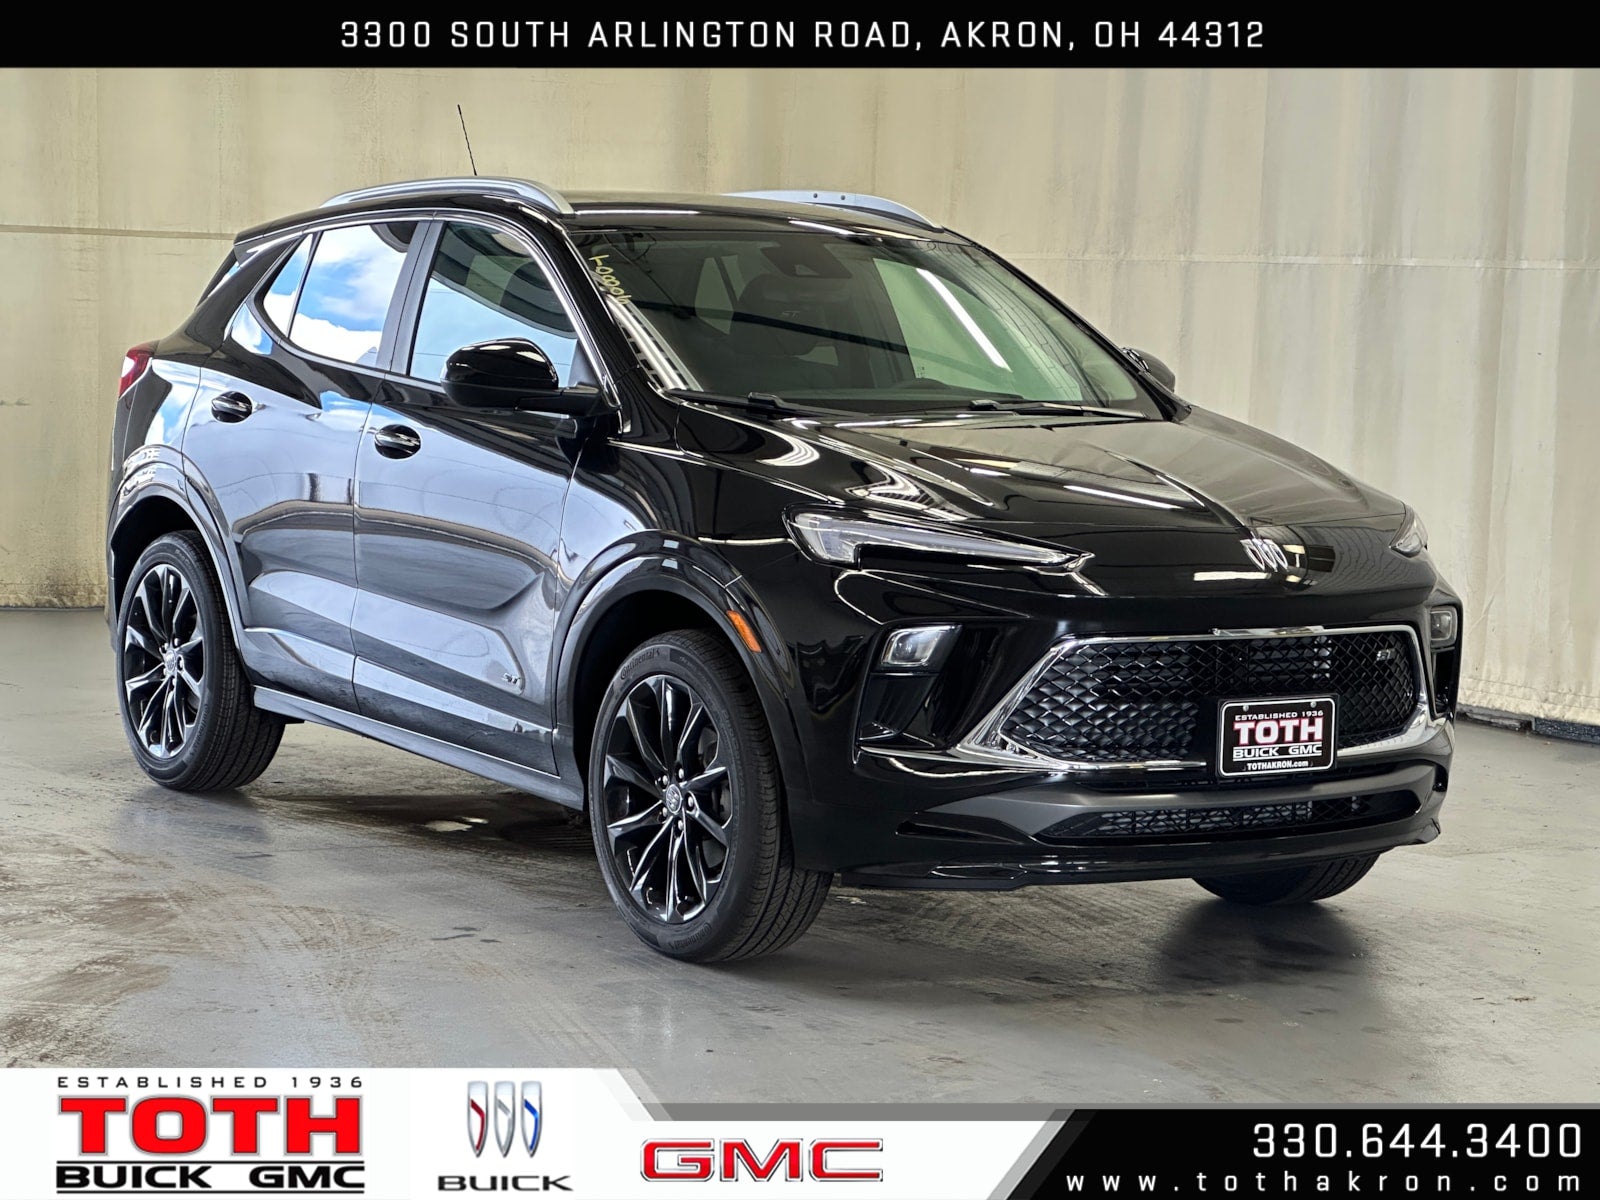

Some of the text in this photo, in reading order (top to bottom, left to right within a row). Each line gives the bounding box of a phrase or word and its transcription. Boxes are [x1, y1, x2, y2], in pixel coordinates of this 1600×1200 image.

[1235, 709, 1324, 721] ESTABLISHED 1936
[1233, 717, 1324, 746] TOTH
[1233, 743, 1323, 759] BUICK GMC
[1246, 760, 1309, 771] TOTHAKRON.com
